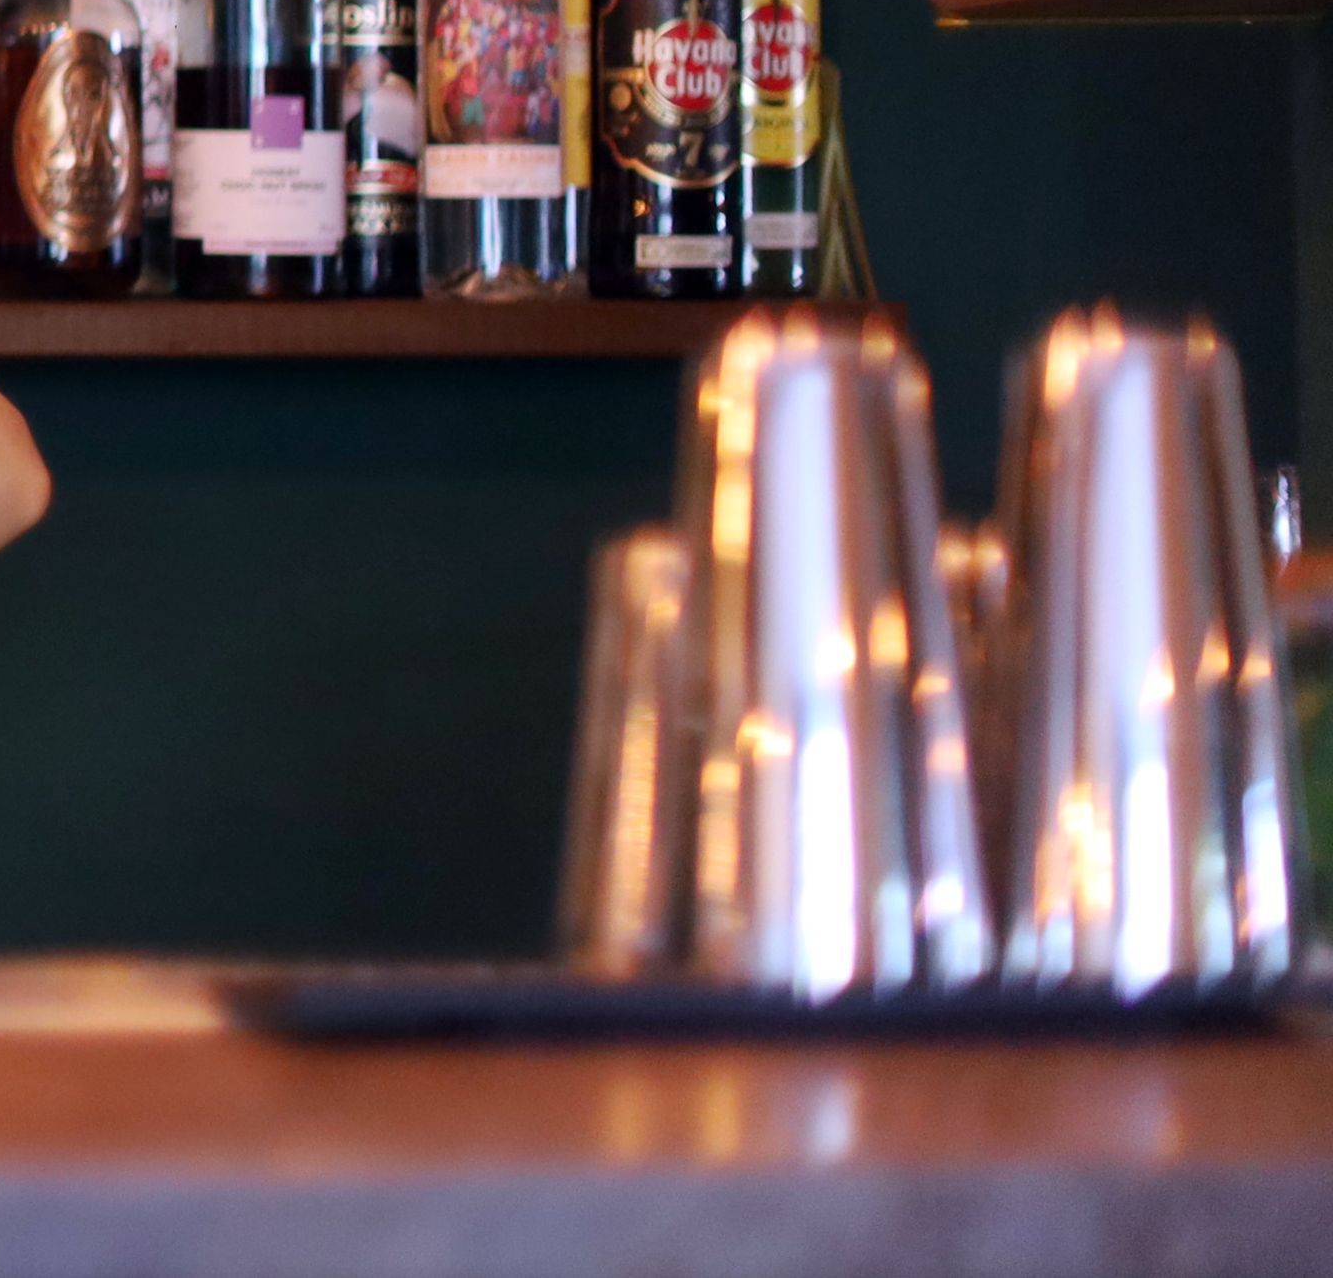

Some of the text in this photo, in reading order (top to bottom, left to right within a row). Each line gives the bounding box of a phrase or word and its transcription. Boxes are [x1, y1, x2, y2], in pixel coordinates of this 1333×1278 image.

[632, 27, 738, 65] Havana
[744, 49, 805, 78] Club
[654, 66, 723, 99] Club
[679, 132, 704, 168] 7
